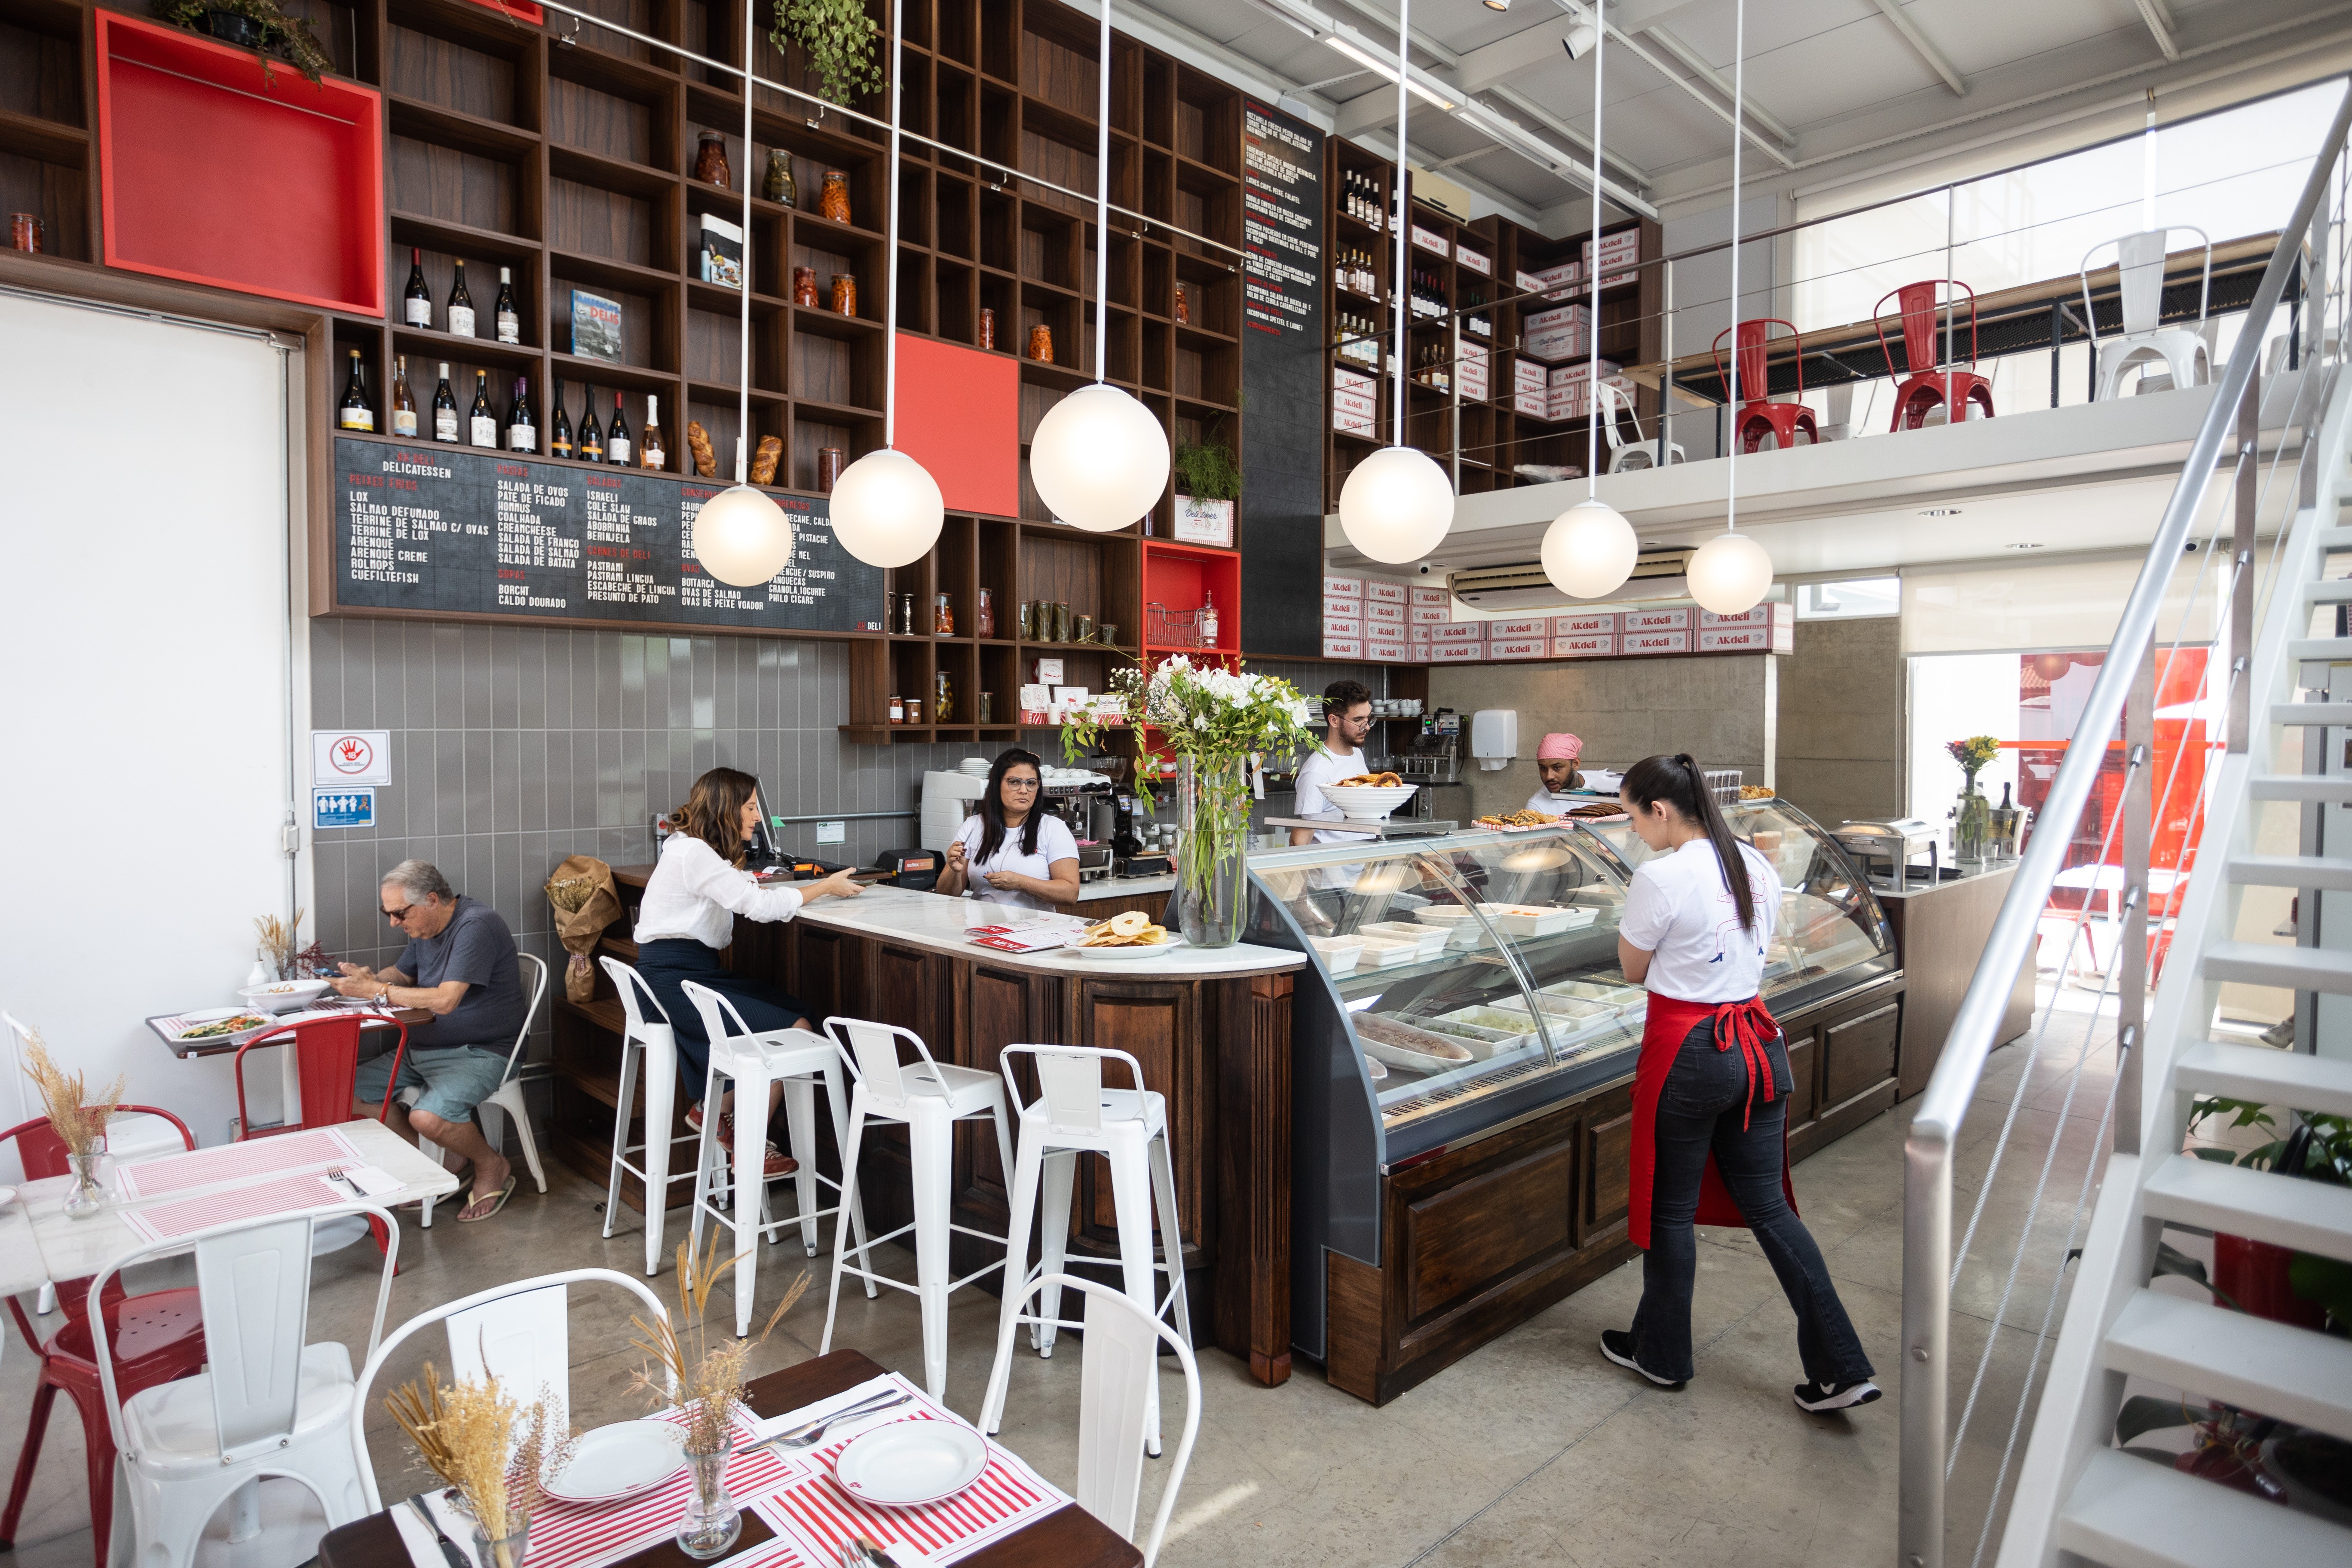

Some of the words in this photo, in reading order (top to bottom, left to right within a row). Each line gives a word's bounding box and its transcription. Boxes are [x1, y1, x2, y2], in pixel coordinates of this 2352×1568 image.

[1422, 236, 1438, 248] AKdeli
[1464, 254, 1481, 267] AKdeli
[591, 306, 619, 325] DELIS
[1463, 346, 1478, 357] AKdeli
[1461, 364, 1478, 376] AKdeli
[1345, 378, 1363, 389] AKdeli
[1463, 386, 1477, 395] AKdeli
[1344, 399, 1362, 409] AKdeli
[1344, 420, 1361, 429] AKdeli
[383, 461, 451, 479] DELICATESSEN
[497, 464, 527, 477] PASTAS
[349, 474, 383, 487] PEIXES
[389, 478, 417, 491] FRIOS
[587, 475, 621, 488] SALADAS
[497, 480, 530, 493] SALADA
[533, 484, 544, 495] DE
[547, 485, 569, 497] OVOS
[350, 490, 368, 502] LOX
[497, 490, 518, 502] PATE
[521, 493, 532, 504] DE
[535, 494, 566, 507] FIGADO
[587, 490, 618, 503] ISRAELI
[350, 502, 388, 516] SALMAO
[391, 505, 440, 521] DEFUMADO
[498, 500, 531, 514] HOMMUS
[587, 500, 607, 512] COLE
[610, 502, 631, 514] SLAW
[351, 513, 392, 527] TERRINE
[395, 517, 408, 529] DE
[411, 518, 447, 532] SALMAO
[450, 522, 462, 533] C/
[466, 524, 489, 536] OVAS
[497, 511, 541, 525] COALHADA
[587, 510, 618, 523] SALADA
[620, 514, 630, 524] DE
[633, 515, 657, 527] GRAOS
[351, 524, 392, 538] TERRINE
[395, 528, 408, 539] DE
[412, 529, 429, 541] LOX
[497, 521, 557, 537] CREAMCHEESE
[587, 520, 630, 534] ABOBRINHA
[350, 535, 394, 549] ARENQUE
[498, 532, 531, 545] SALADA
[533, 535, 545, 546] DE
[548, 536, 579, 549] FRANGO
[587, 530, 630, 544] BERINJELA
[799, 533, 828, 544] PISTACHE
[350, 546, 394, 560] ARENQUE
[398, 550, 428, 563] CREME
[498, 542, 531, 555] SALADA
[534, 545, 545, 556] DE
[548, 547, 579, 559] SALMAO
[798, 550, 811, 560] MEL
[351, 557, 395, 571] ROLMOPS
[498, 553, 530, 566] SALADA
[533, 556, 545, 567] DE
[548, 557, 576, 569] BATATA
[587, 560, 623, 572] PASTRAMI
[351, 569, 419, 584] GUEFILTEFISH
[498, 569, 525, 580] SOPAS
[587, 570, 623, 582] PASTRAMI
[626, 573, 654, 584] LINGUA
[808, 569, 835, 580] SUSPIRO
[587, 580, 632, 593] ESCABECHE
[636, 584, 646, 594] DE
[649, 585, 676, 596] LINGUA
[681, 577, 715, 589] BOTTARGA
[498, 584, 530, 596] BORCHT
[682, 587, 700, 597] OVAS
[702, 588, 712, 598] DE
[714, 589, 741, 600] SALMAO
[1378, 589, 1396, 597] AKdeli
[498, 594, 526, 606] CALDO
[529, 596, 566, 609] DOURADO
[588, 590, 626, 602] PRESUNTO
[628, 593, 638, 603] DE
[641, 594, 659, 604] PATO
[682, 596, 700, 606] OVAS
[702, 597, 712, 607] DE
[714, 598, 735, 609] PEIXE
[738, 600, 764, 610] VOADOR
[768, 593, 788, 603] PHILO
[790, 594, 814, 605] CIGARS
[1641, 616, 1671, 625] AKdeli
[1718, 612, 1750, 622] AKdeli
[867, 622, 881, 631] DELI
[1443, 628, 1467, 636] AKdeli
[1505, 624, 1531, 633] AKdeli
[1570, 621, 1599, 630] AKdeli
[1569, 641, 1597, 649] AKdeli
[1640, 638, 1669, 647] AKdeli
[1717, 635, 1749, 644] AKdeli
[1444, 648, 1468, 656] AKdeli
[1505, 645, 1531, 653] AKdeli
